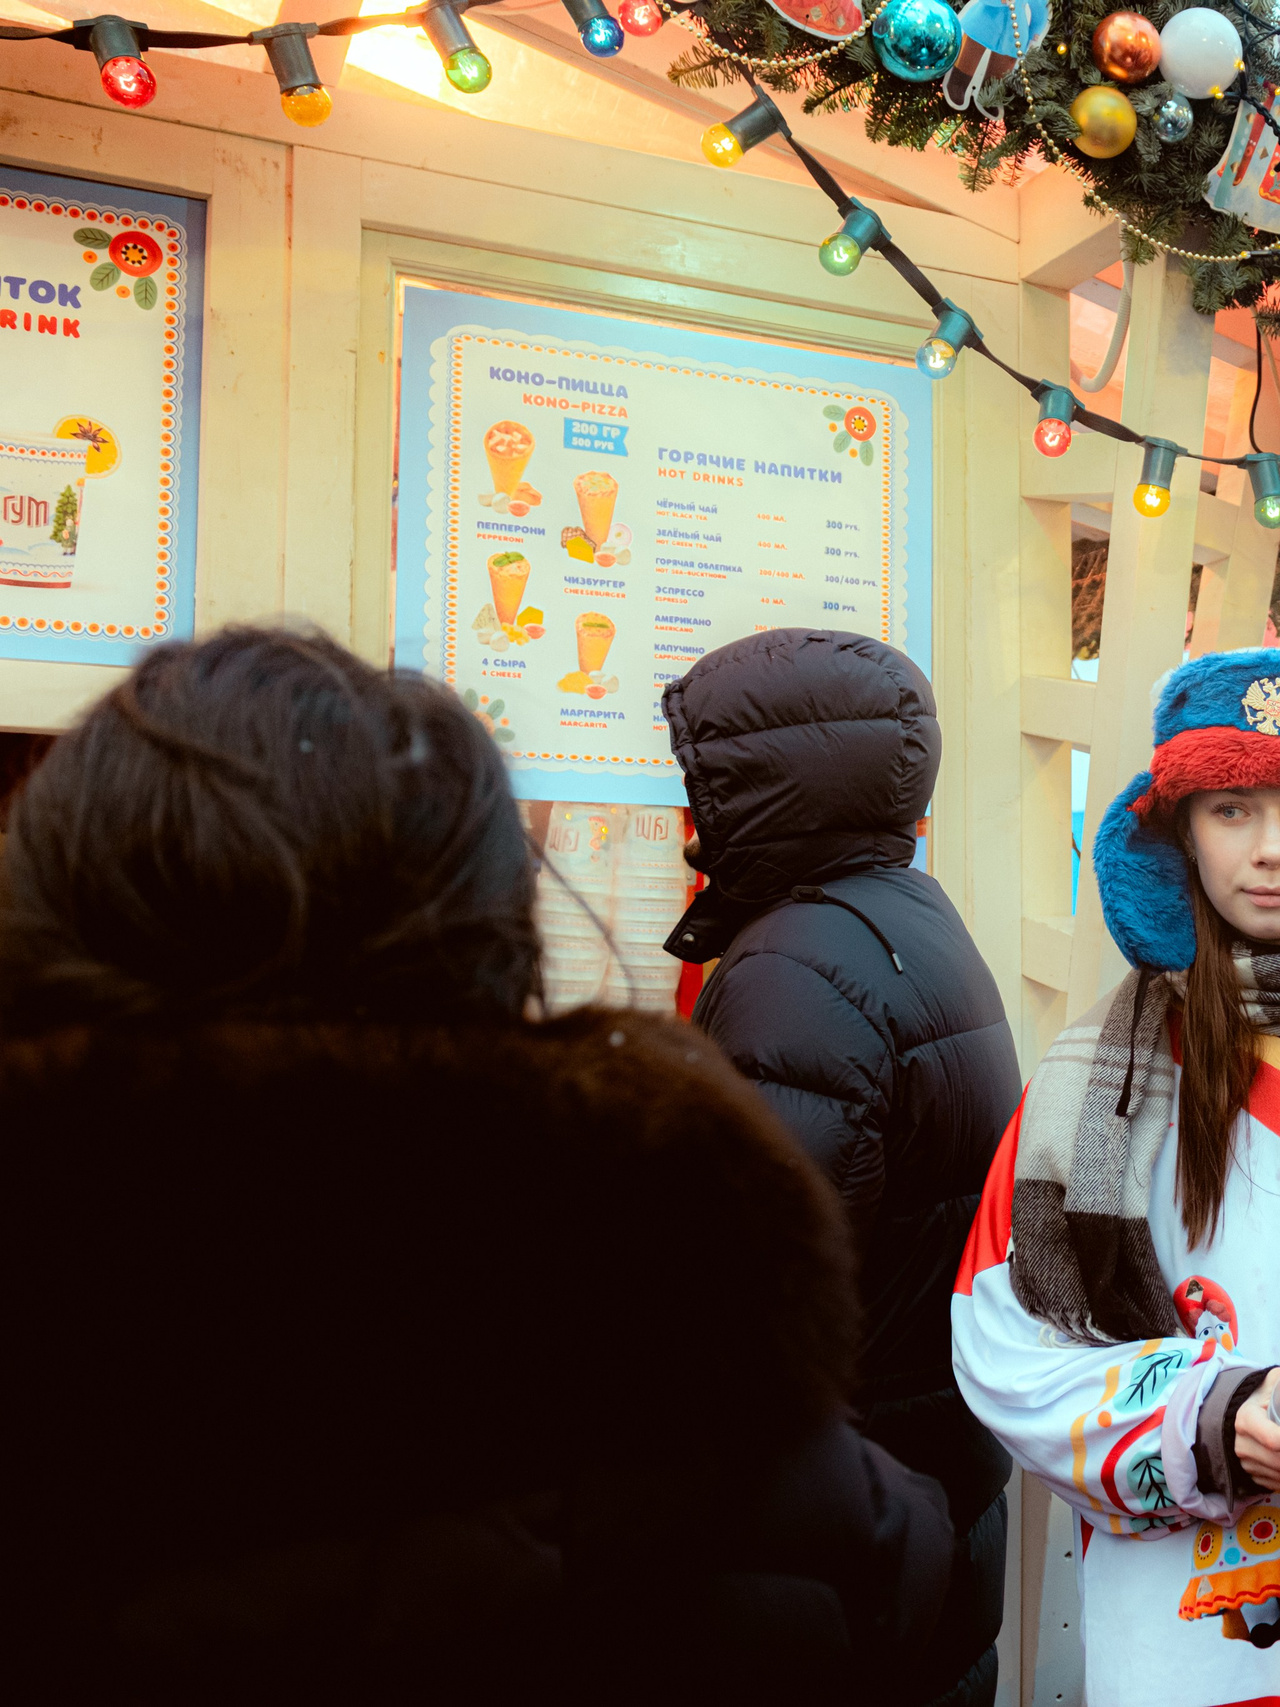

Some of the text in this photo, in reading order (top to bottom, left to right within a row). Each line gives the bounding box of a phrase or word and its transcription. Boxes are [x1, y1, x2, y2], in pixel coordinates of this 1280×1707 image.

[0, 276, 81, 309] ТОК
[489, 366, 628, 399] КОНО-ПИЦЦА
[522, 393, 628, 419] KONO-PIZZA
[572, 421, 621, 439] 200 ГР
[571, 436, 615, 451] 500 РУБ
[658, 447, 842, 484] ГОРЯЧИЕ НАПИТКИ
[658, 467, 744, 487] HOT DRINKS
[656, 498, 718, 514] ЧЁРНЫЙ ЧАЙ
[672, 511, 693, 519] BLACK
[477, 520, 546, 536] ПЕППЕРОНИ
[825, 520, 843, 530] 300
[476, 533, 524, 544] PEPPERONI
[656, 528, 722, 542] ЗЕЛЁНЫЙ ЧАЙ
[824, 547, 842, 556] 300
[656, 557, 743, 573] ГОРЯЧАЯ ОБЛЕПИХА
[563, 575, 626, 589] ЧИЗБУРГЕР
[824, 575, 860, 585] 300/400
[563, 587, 626, 599] CHEESEBURGER
[655, 586, 705, 598] ЭСПРЕССО
[655, 596, 688, 604] ESPRESSO
[823, 601, 840, 611] 300
[654, 615, 712, 627] АМЕРИКАНО
[654, 625, 694, 633] AMERICANO
[654, 643, 706, 655] КАПУЧИНО
[482, 658, 527, 669] 4 СЫРА
[654, 653, 697, 662] CAPPUCCINO
[490, 670, 522, 679] CHEESE
[560, 708, 626, 721] МАРГАРИТА
[559, 720, 608, 729] MARGARITA
